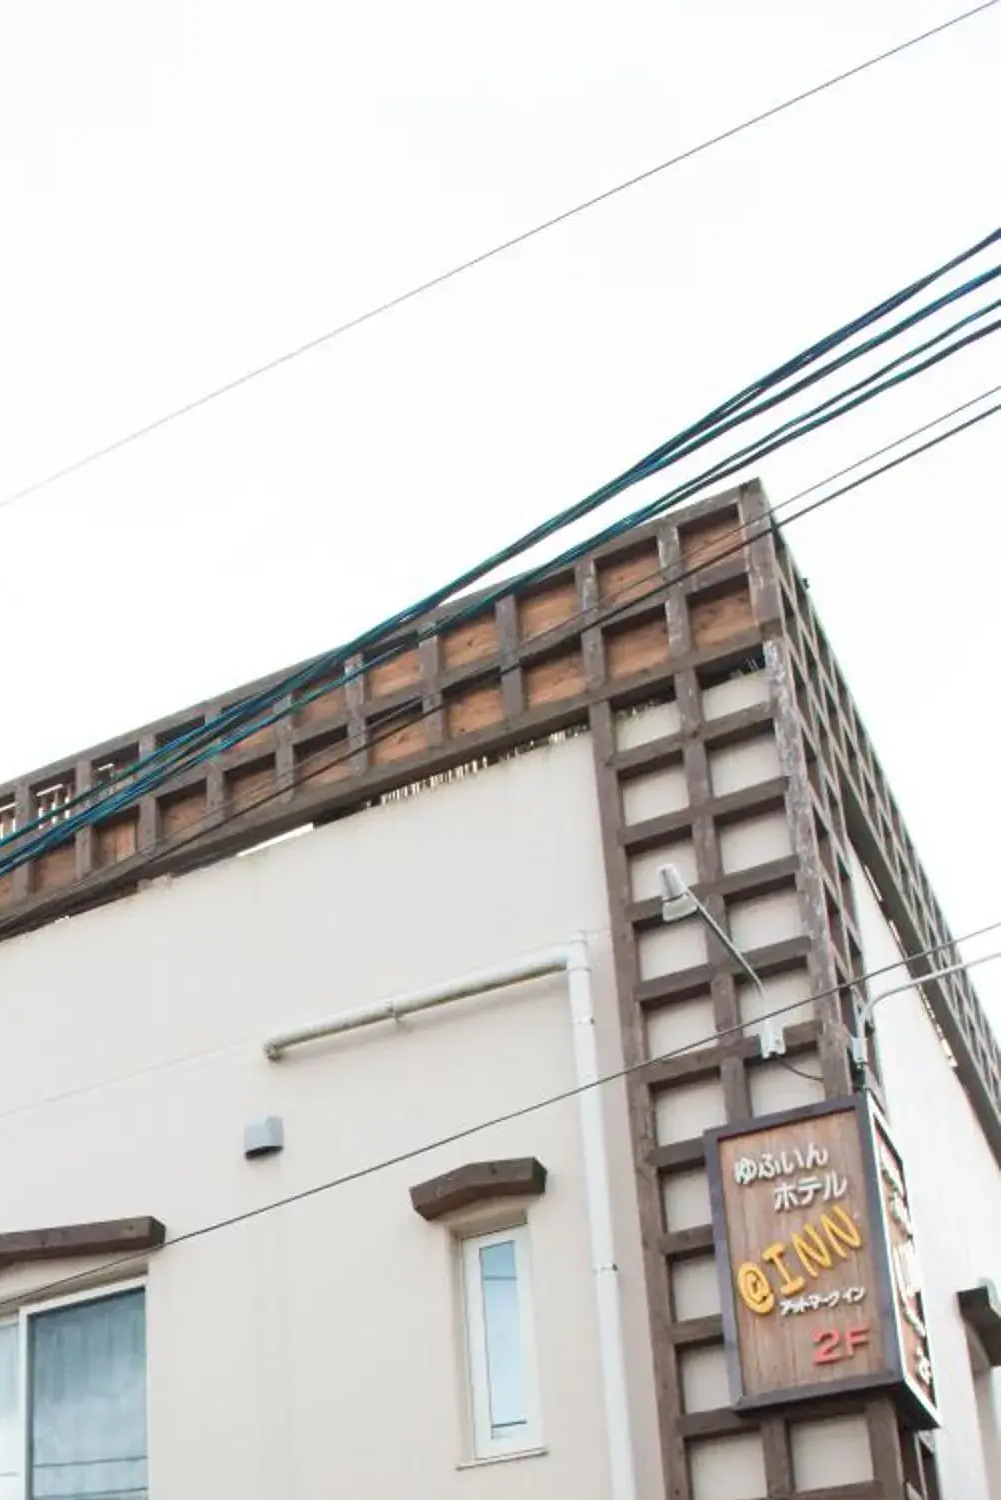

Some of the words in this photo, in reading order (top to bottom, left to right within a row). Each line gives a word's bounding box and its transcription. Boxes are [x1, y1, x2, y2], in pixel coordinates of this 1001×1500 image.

[734, 1143, 828, 1185] ゆふいん
[774, 1175, 848, 1211] ホテル
[737, 1206, 863, 1316] @INN
[813, 1328, 869, 1364] 2F
